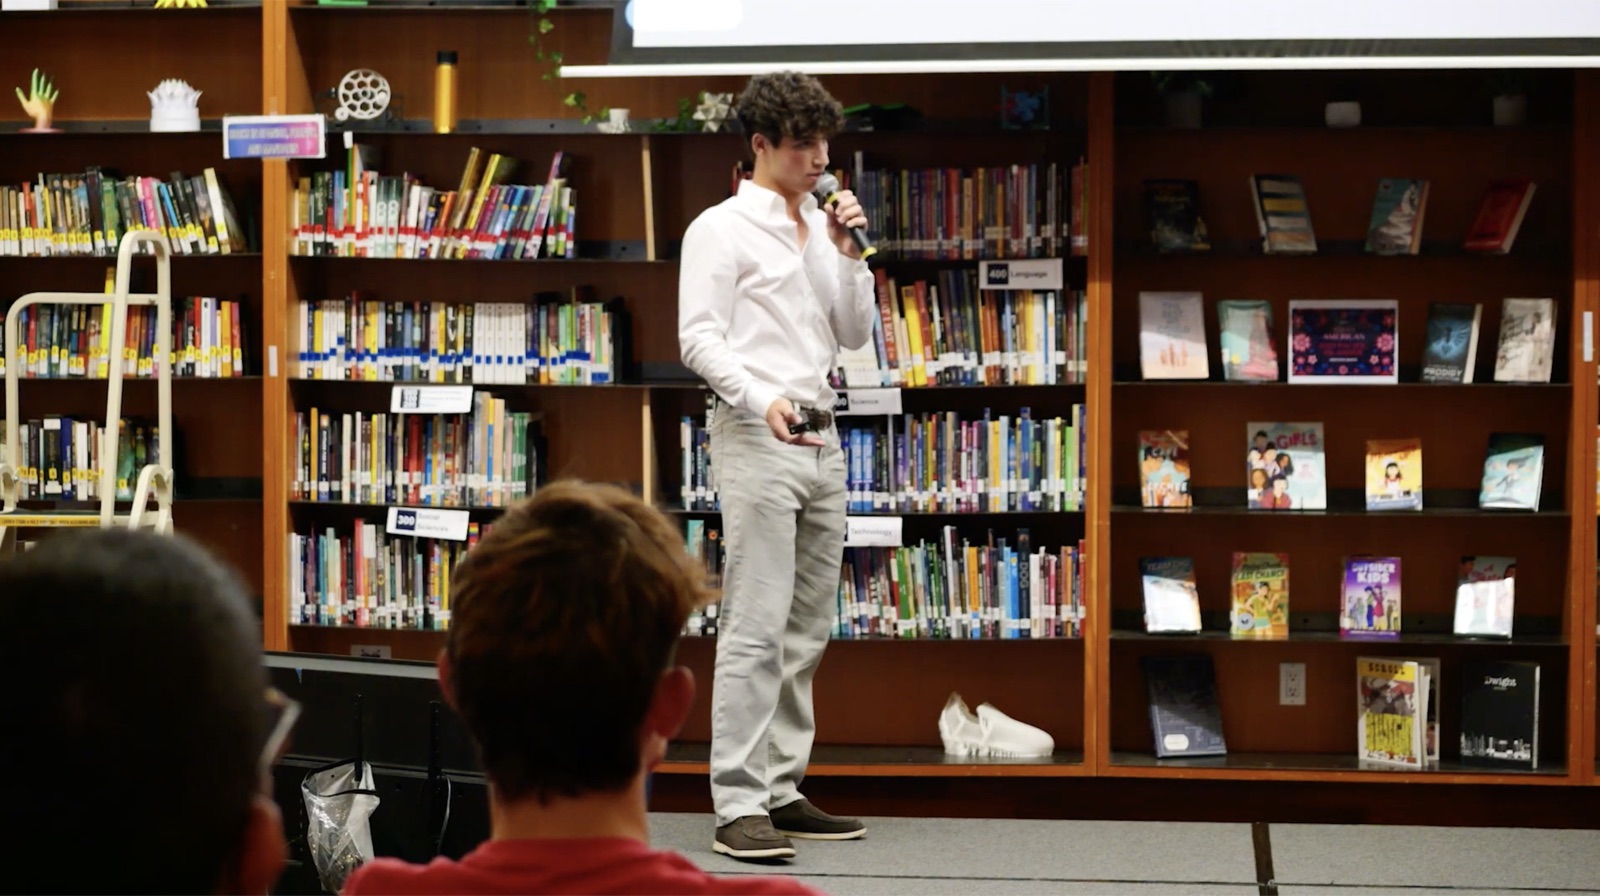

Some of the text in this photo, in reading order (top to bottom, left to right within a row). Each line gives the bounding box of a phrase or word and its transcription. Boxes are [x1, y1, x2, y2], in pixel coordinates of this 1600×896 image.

[989, 269, 1048, 279] 400 Language
[1424, 367, 1462, 376] PRODIGY
[1276, 432, 1318, 449] GIRLS
[397, 514, 415, 526] 300
[417, 524, 449, 532] Sciences
[850, 528, 892, 536] Technology
[1019, 562, 1029, 588] DOG
[1356, 572, 1390, 584] KIDS
[1484, 675, 1518, 688] Dwight
